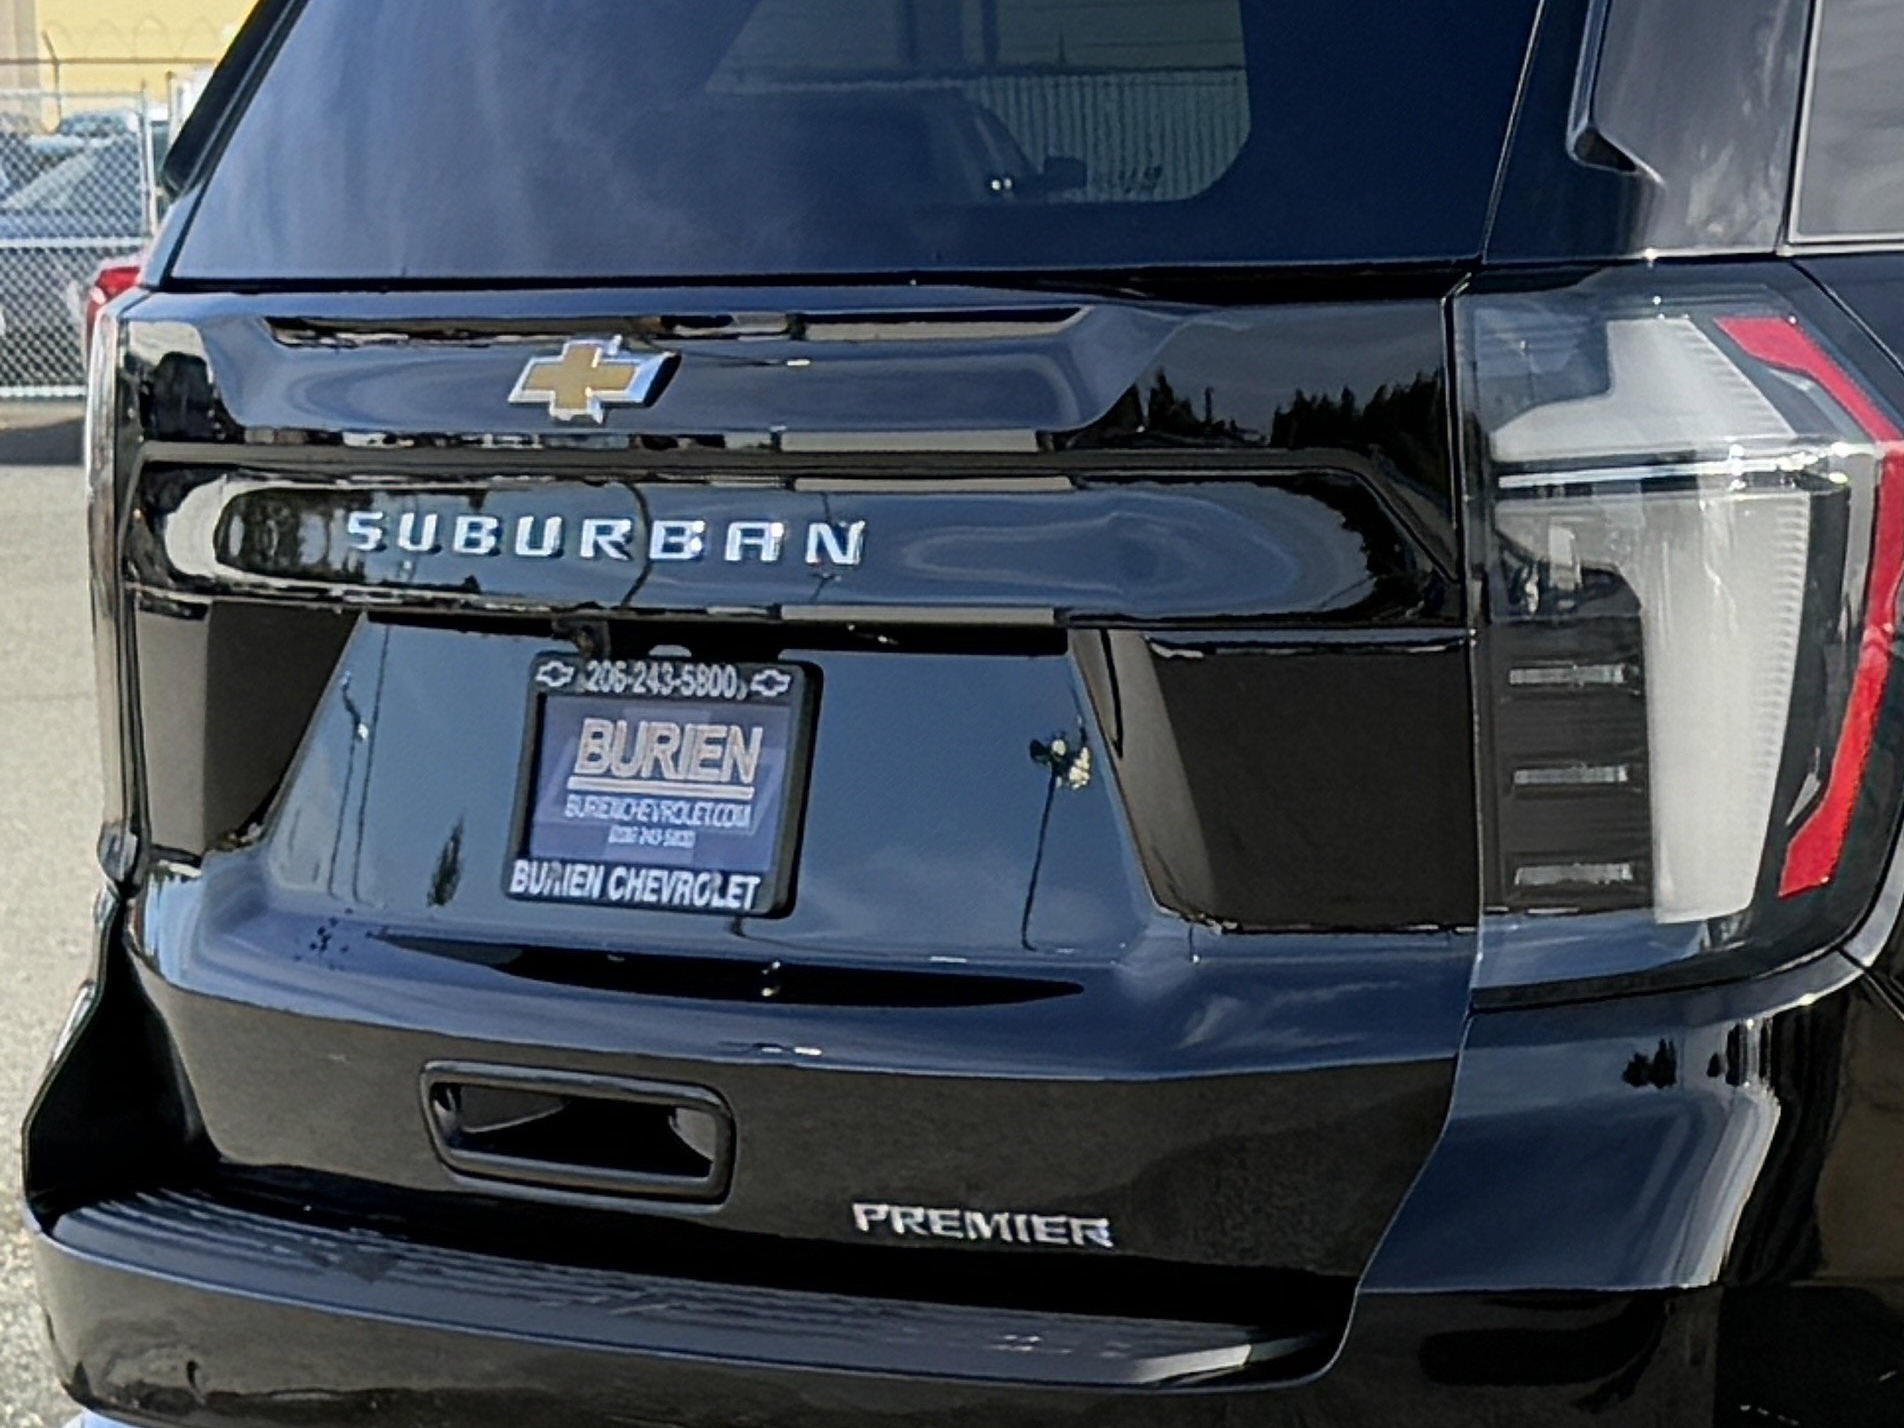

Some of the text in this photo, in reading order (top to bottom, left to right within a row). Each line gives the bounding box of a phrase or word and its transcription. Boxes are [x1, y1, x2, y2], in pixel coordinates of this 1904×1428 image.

[346, 511, 866, 565] SUBURBAN
[585, 660, 738, 699] 206-243-5800
[573, 717, 764, 784] BURIEN
[509, 859, 761, 910] BURIEN CHEVROLET
[852, 1202, 1114, 1248] PREMIER
